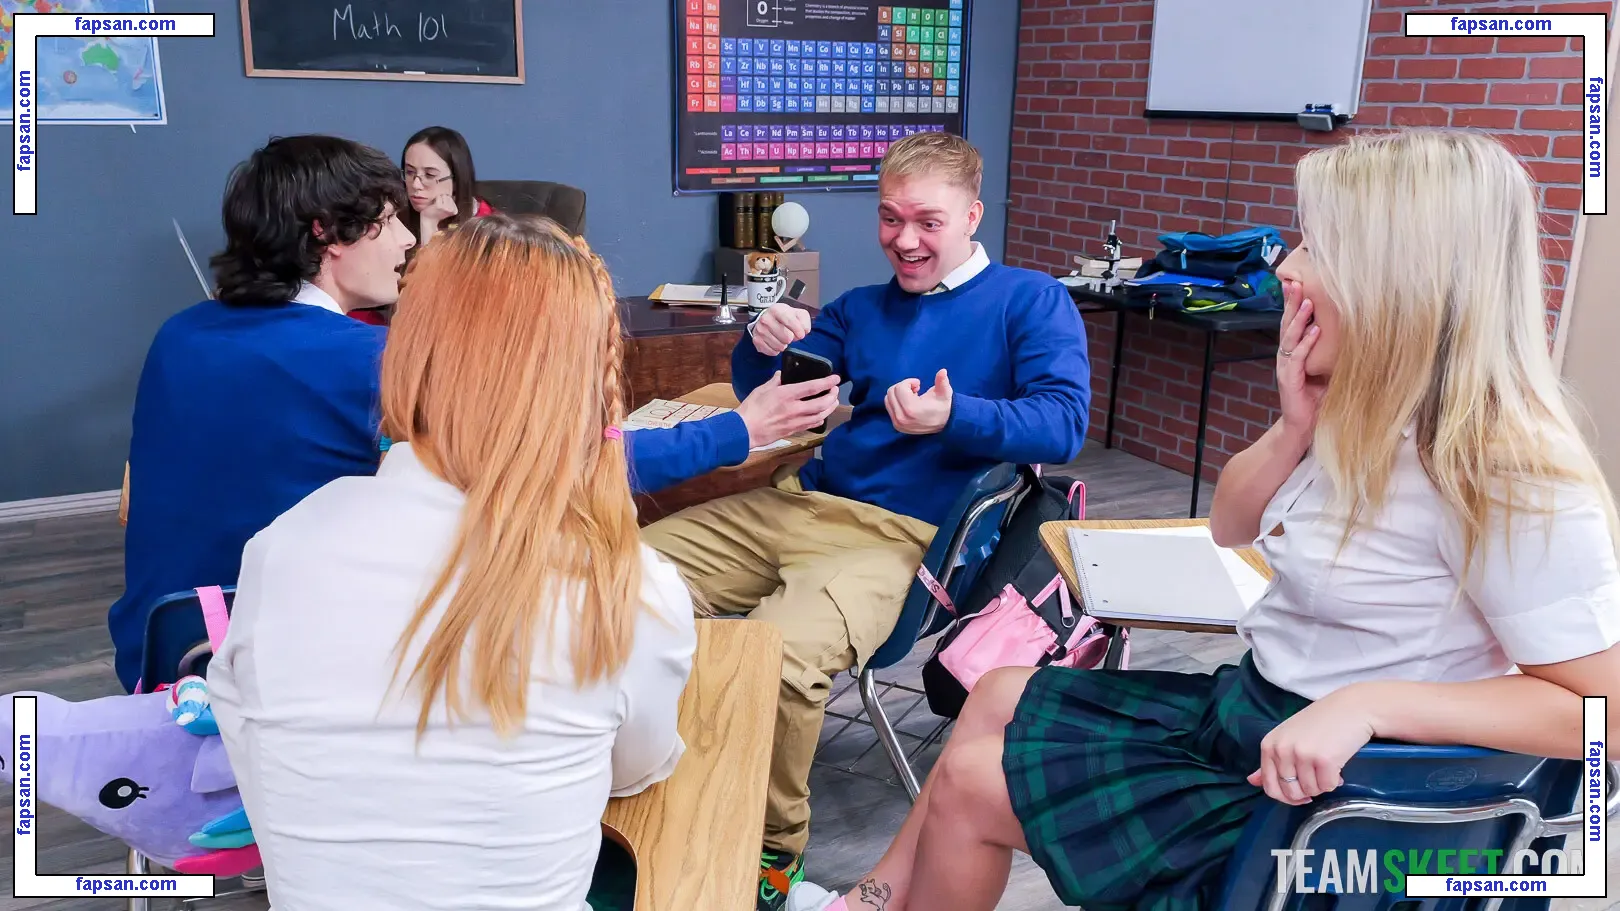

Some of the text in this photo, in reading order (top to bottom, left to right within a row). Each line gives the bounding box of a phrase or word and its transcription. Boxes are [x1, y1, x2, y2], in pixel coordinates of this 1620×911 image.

[333, 3, 448, 43] Math 101
[706, 22, 717, 32] Mg
[850, 65, 858, 74] Ag
[864, 82, 873, 92] Hg
[773, 100, 781, 109] Sg
[863, 129, 872, 138] Dy
